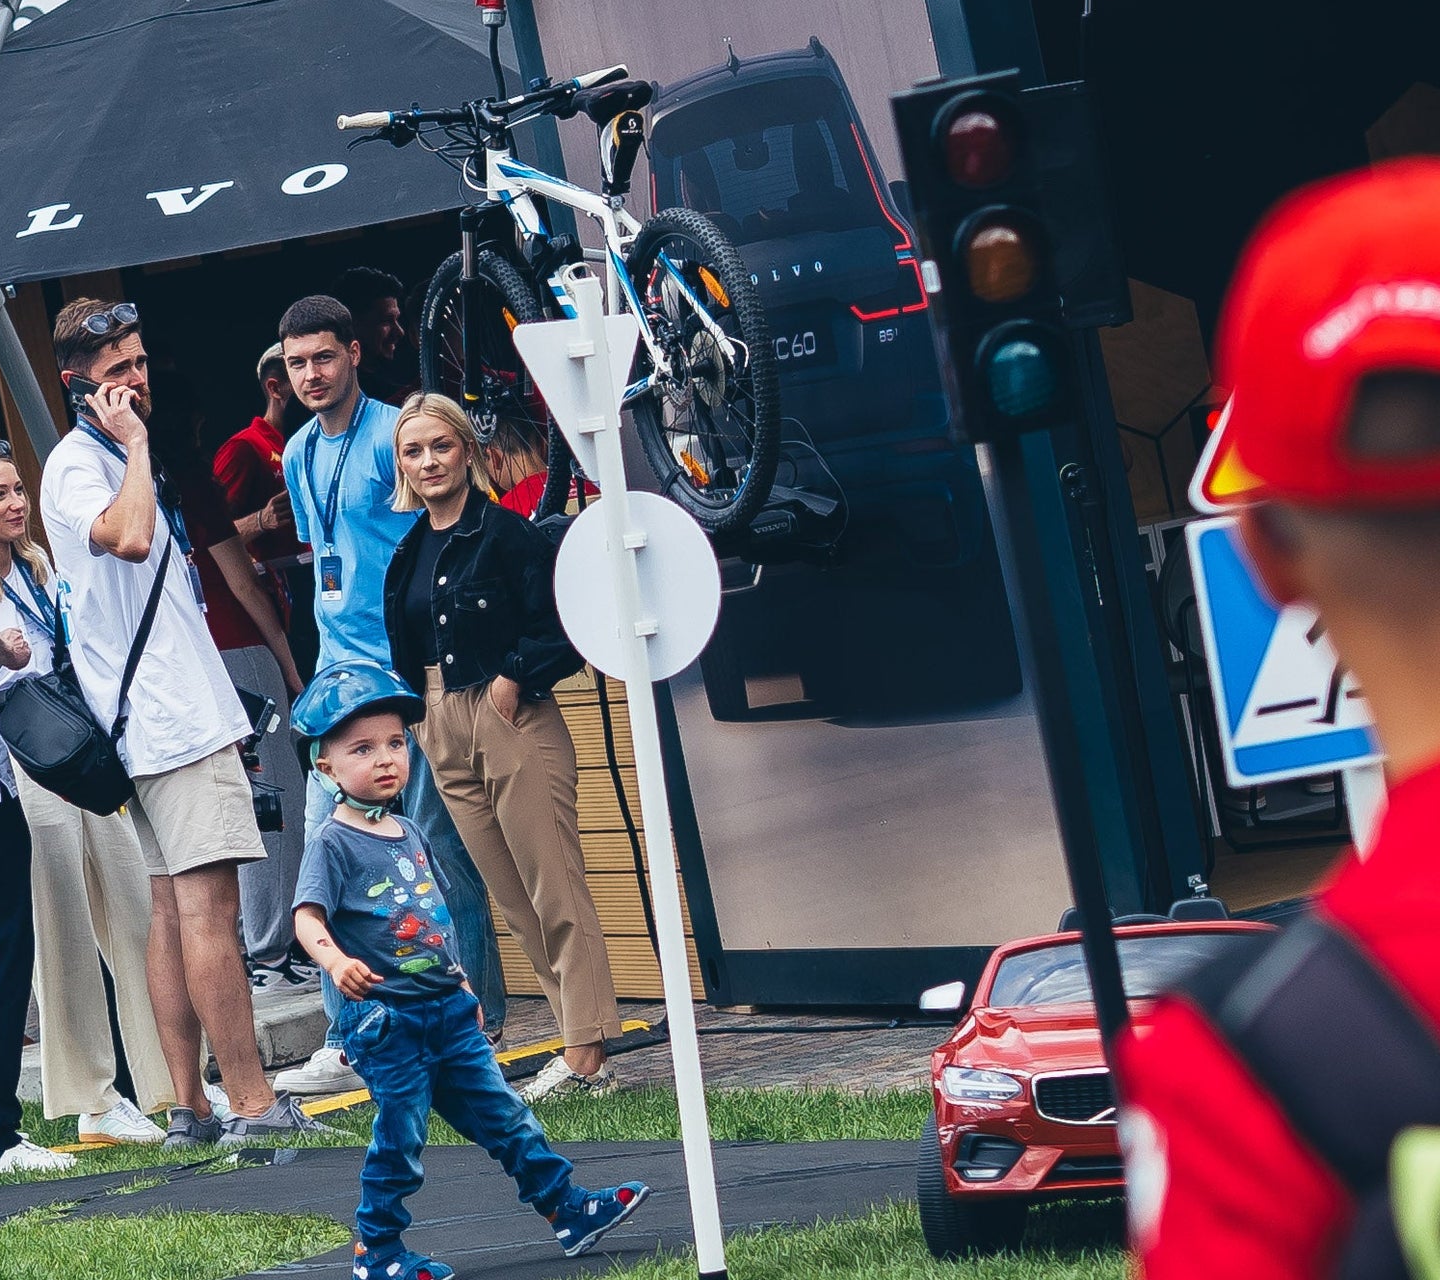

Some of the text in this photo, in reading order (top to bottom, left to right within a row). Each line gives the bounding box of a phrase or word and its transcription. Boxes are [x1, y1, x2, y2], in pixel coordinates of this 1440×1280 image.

[750, 261, 823, 286] OLVO
[772, 331, 816, 360] C60
[754, 520, 788, 535] VOLVO
